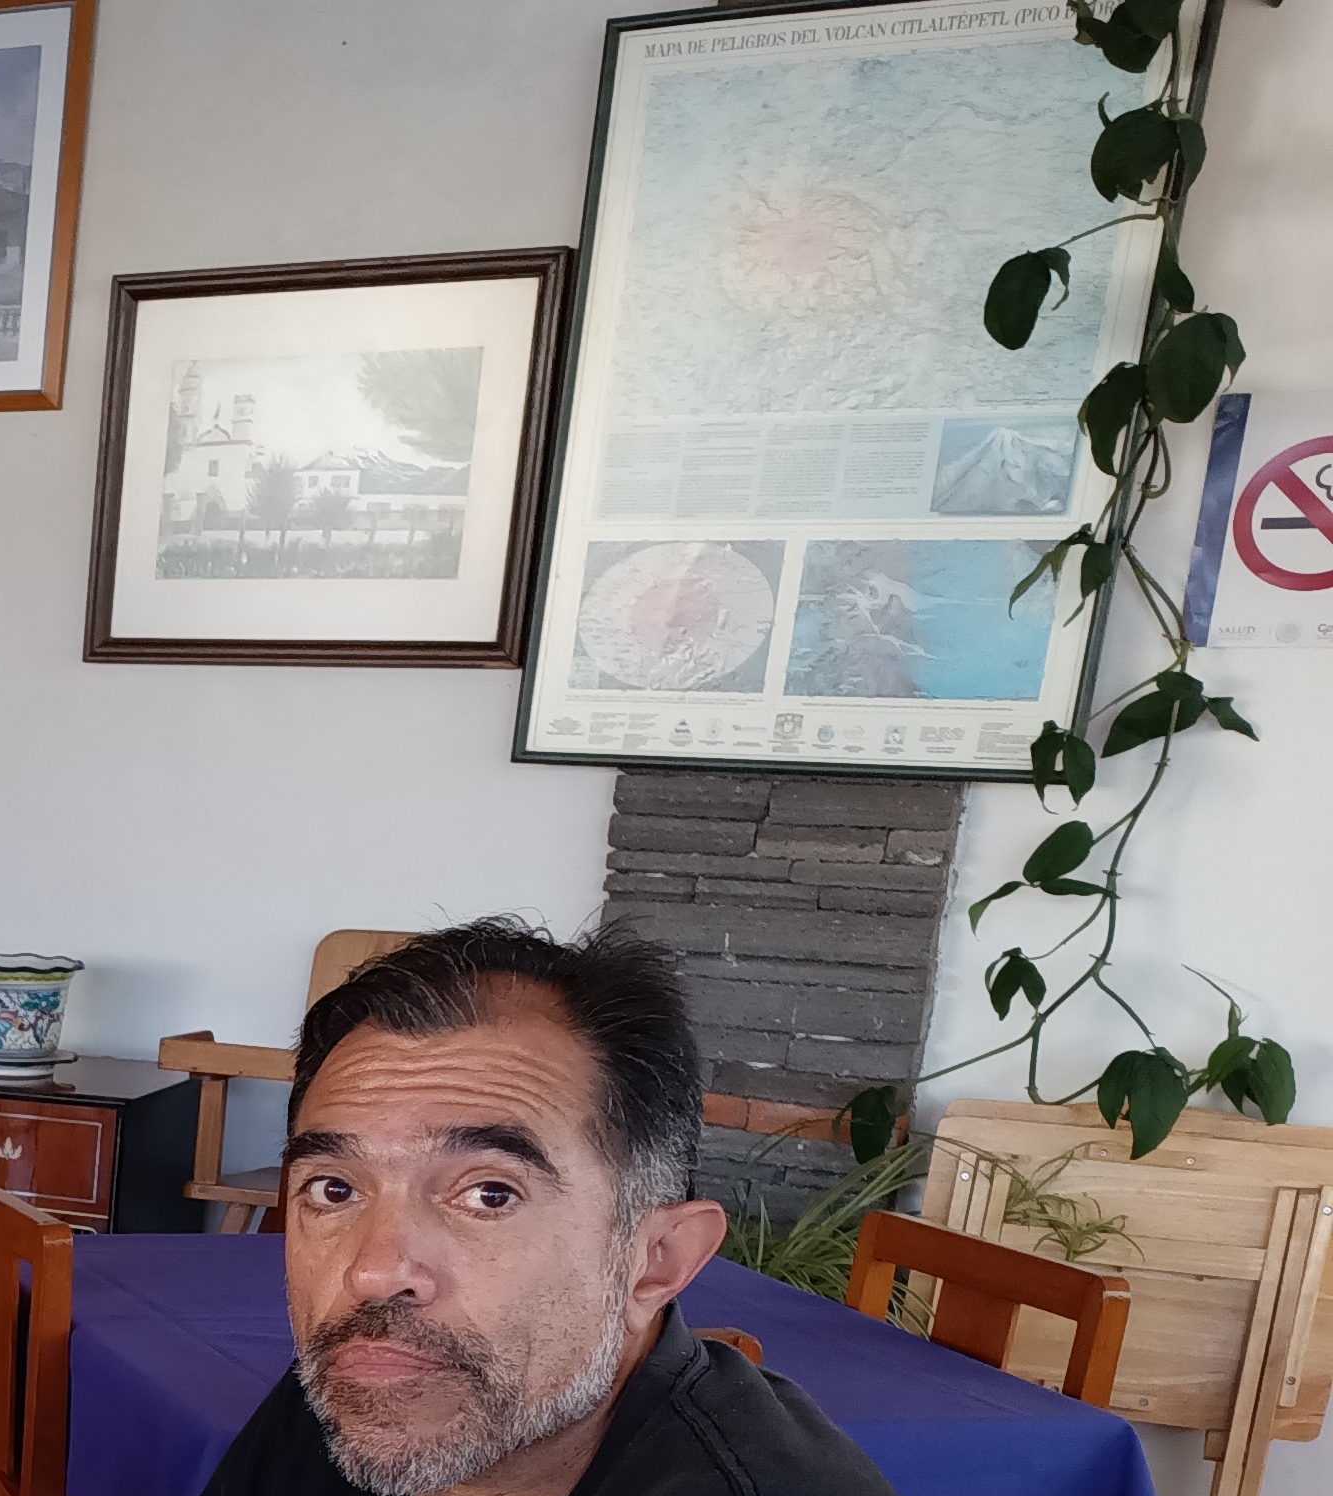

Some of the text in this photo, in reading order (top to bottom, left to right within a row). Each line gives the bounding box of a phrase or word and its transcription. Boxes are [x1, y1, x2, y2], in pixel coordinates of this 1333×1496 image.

[644, 41, 683, 58] MAPA
[687, 38, 709, 55] DE
[710, 31, 787, 53] PELIGROS
[790, 28, 821, 45] DEL
